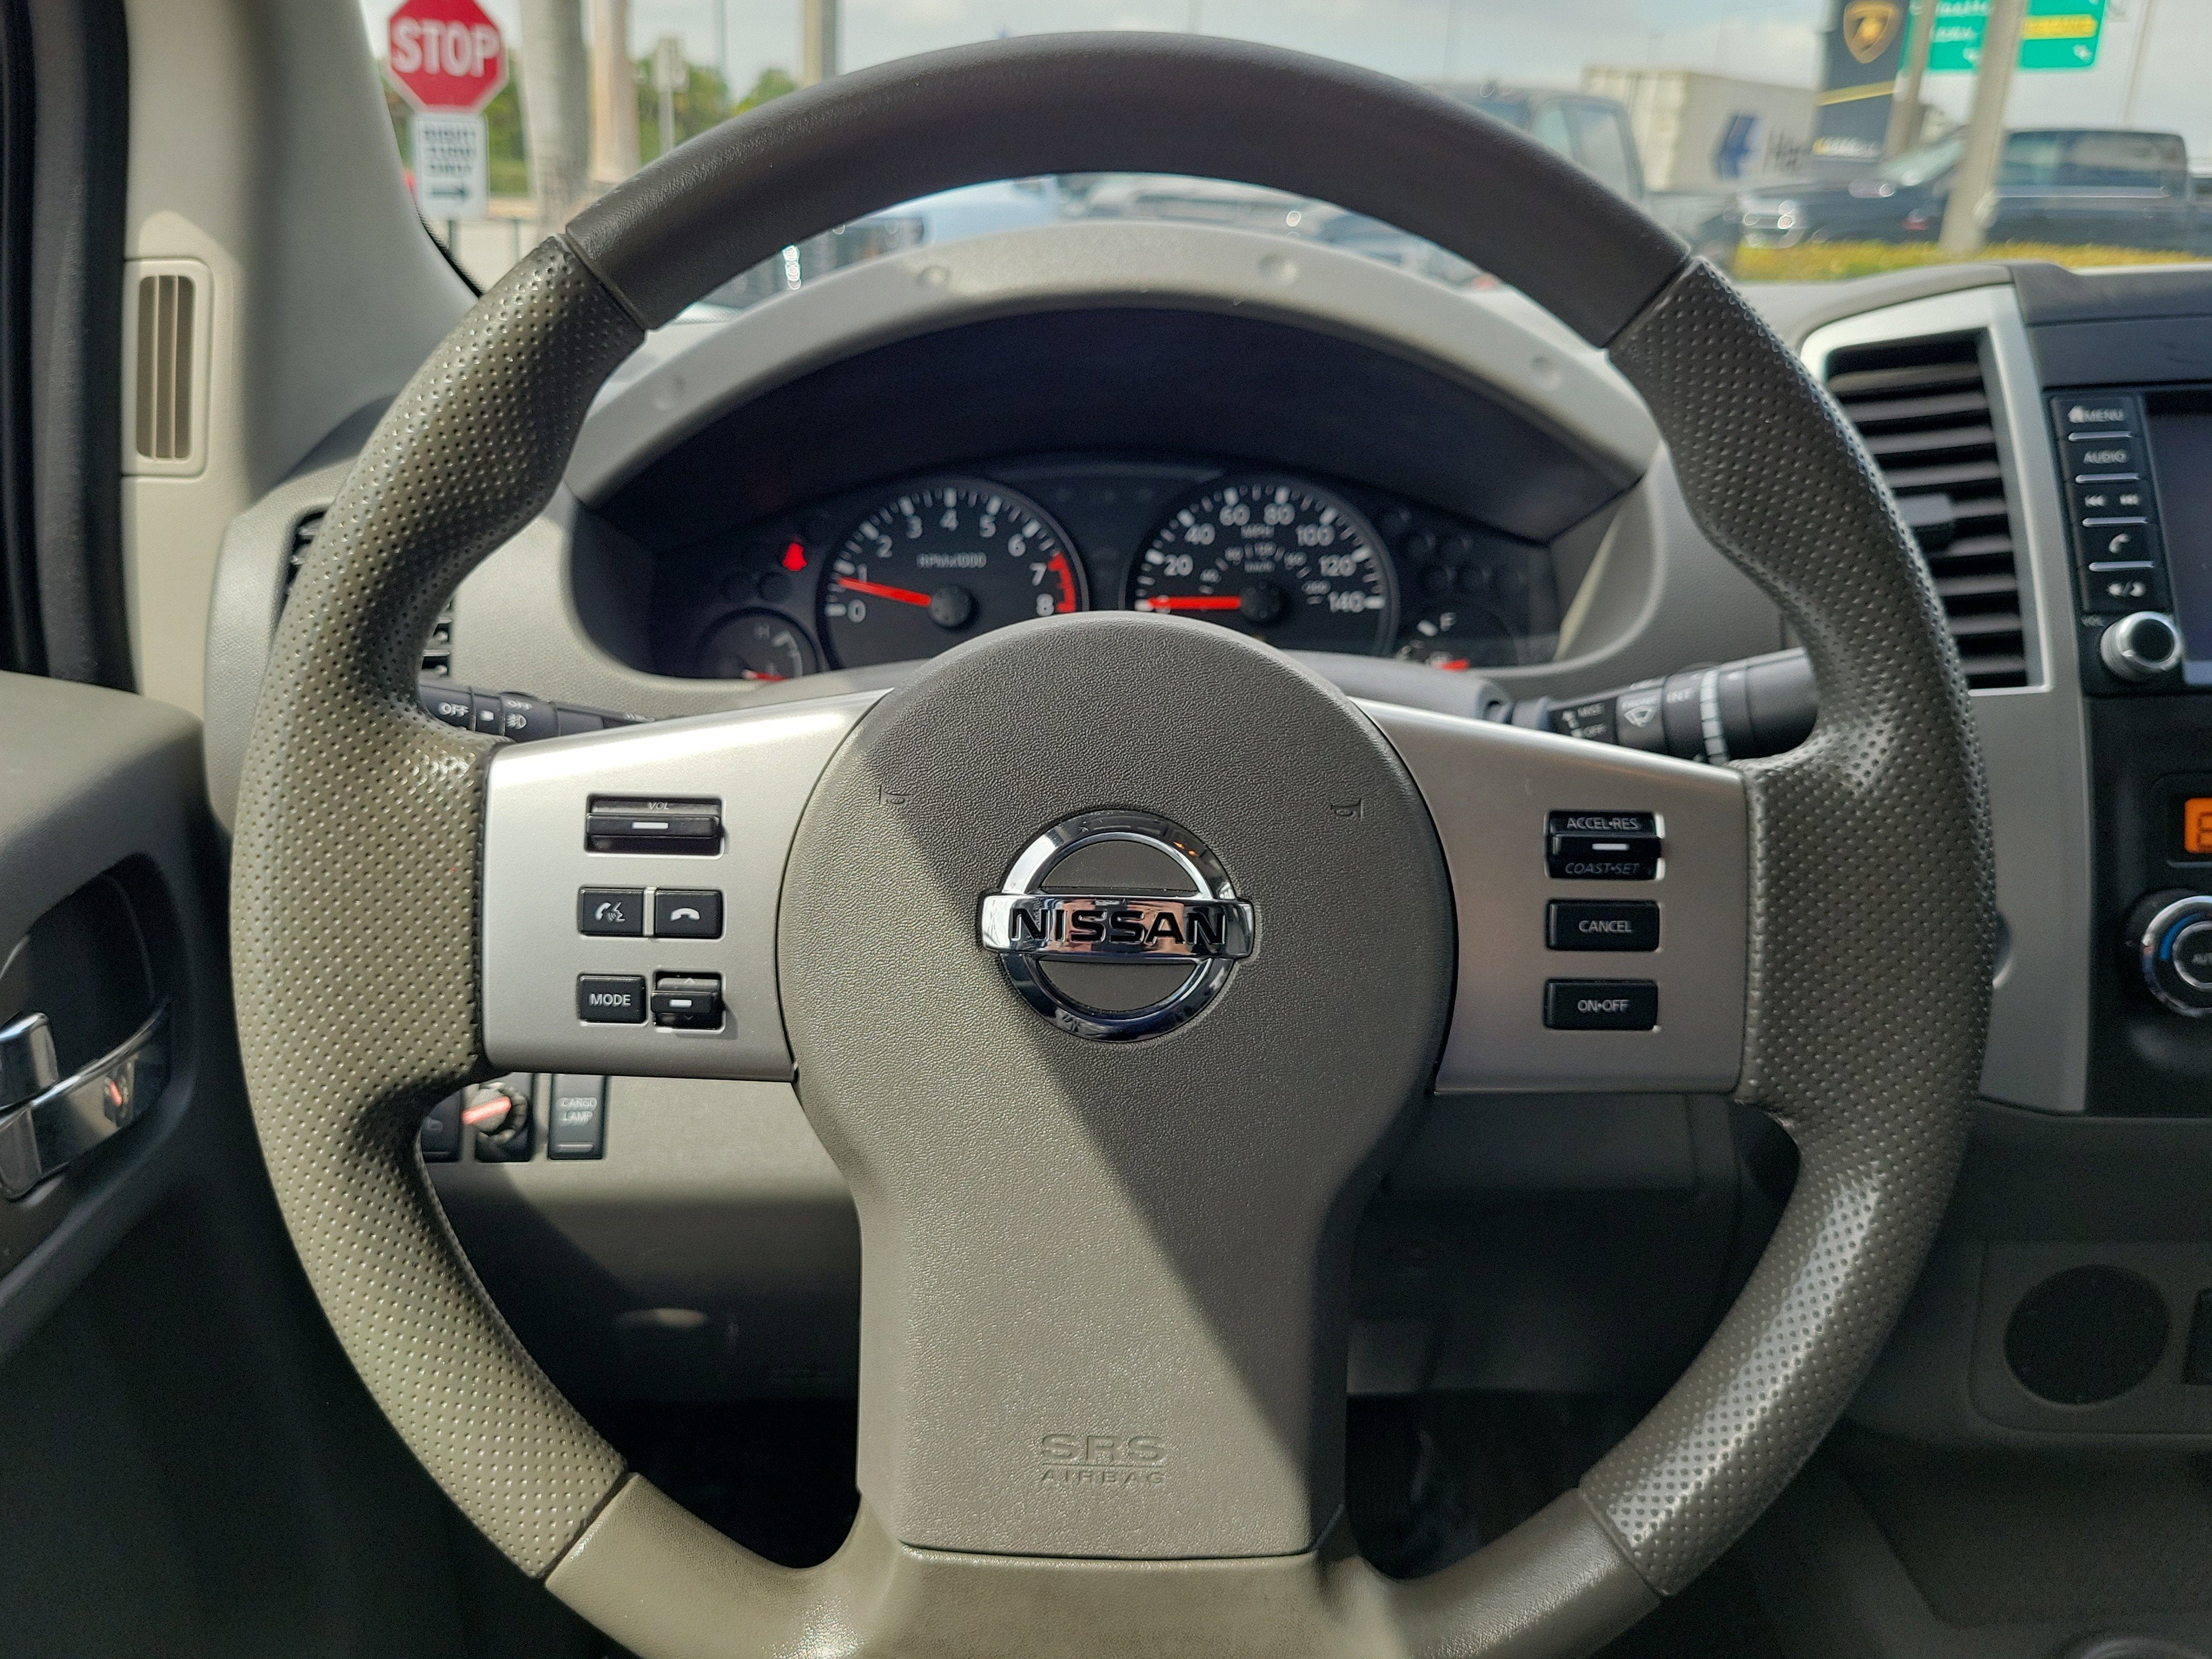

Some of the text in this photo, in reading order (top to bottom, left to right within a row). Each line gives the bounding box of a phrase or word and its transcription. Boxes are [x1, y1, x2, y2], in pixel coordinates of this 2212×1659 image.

[390, 16, 500, 78] STOP
[2085, 408, 2124, 422] MENU
[2083, 449, 2128, 464] AUDIO
[940, 509, 958, 531] 4
[979, 514, 996, 538] 5
[1220, 503, 1250, 526] 60
[1264, 503, 1295, 526] 80
[906, 515, 922, 539] 3
[1185, 522, 1215, 545] 40
[1296, 523, 1335, 547] 100
[877, 535, 892, 557] 2
[1008, 534, 1026, 556] 6
[1030, 563, 1047, 586] 7
[1164, 554, 1193, 577] 20
[1319, 554, 1356, 577] 120
[848, 599, 866, 623] 0
[1036, 594, 1054, 617] 8
[1328, 590, 1365, 613] 140
[439, 702, 469, 718] OFF
[648, 802, 669, 810] VOL
[1011, 907, 1226, 945] NISSAN
[1578, 920, 1632, 933] CANCEL
[589, 993, 631, 1006] MODE
[556, 1097, 597, 1111] CARGO
[561, 1111, 592, 1125] LAMP
[1042, 1434, 1167, 1462] SRS
[1042, 1469, 1166, 1485] AIRBAG
